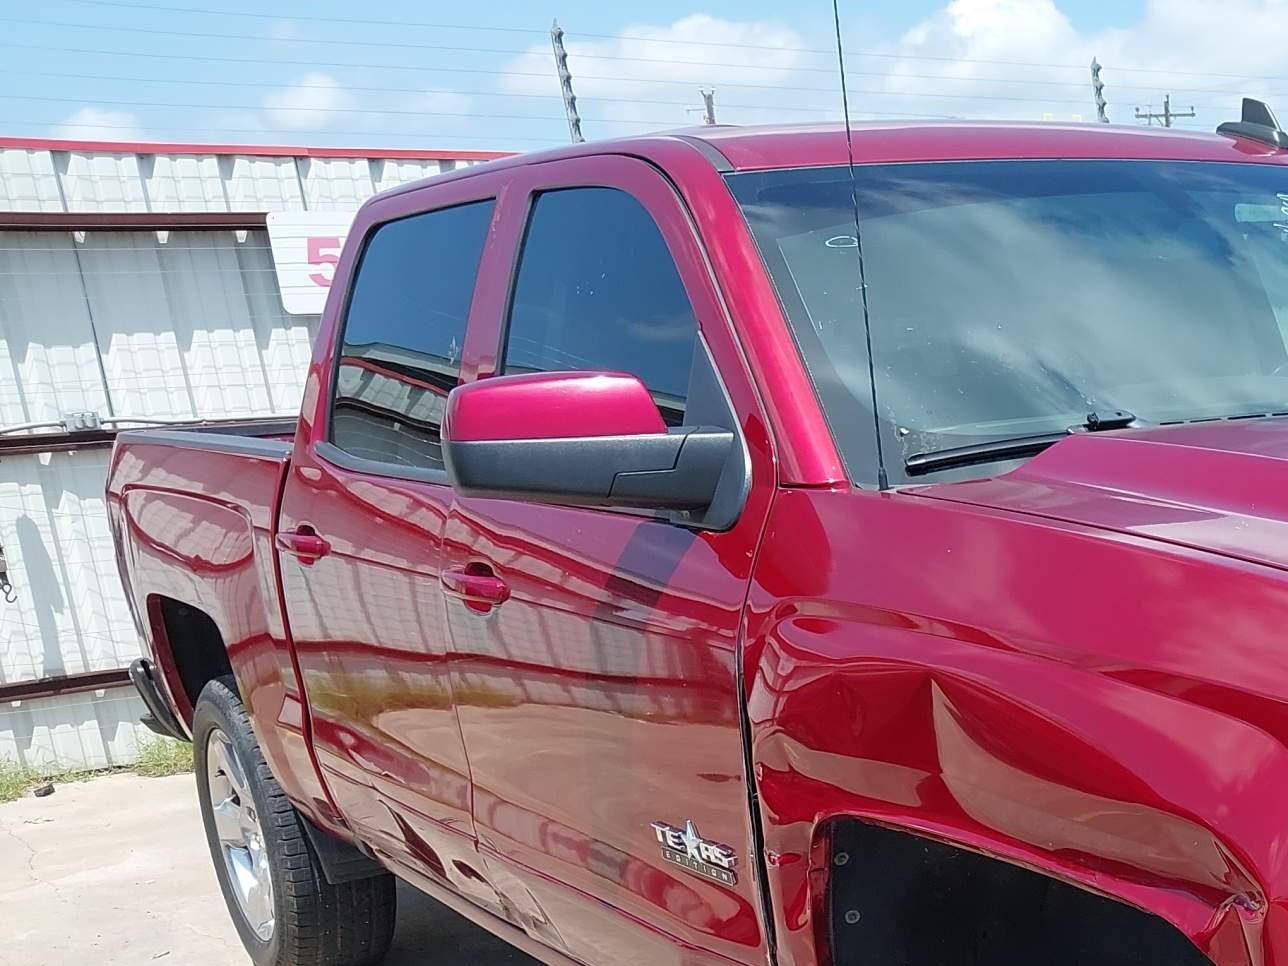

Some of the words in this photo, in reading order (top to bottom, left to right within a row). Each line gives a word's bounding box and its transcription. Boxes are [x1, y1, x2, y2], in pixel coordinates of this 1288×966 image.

[307, 236, 341, 287] 5
[650, 819, 738, 869] TEXAS
[665, 850, 729, 882] EDITION
